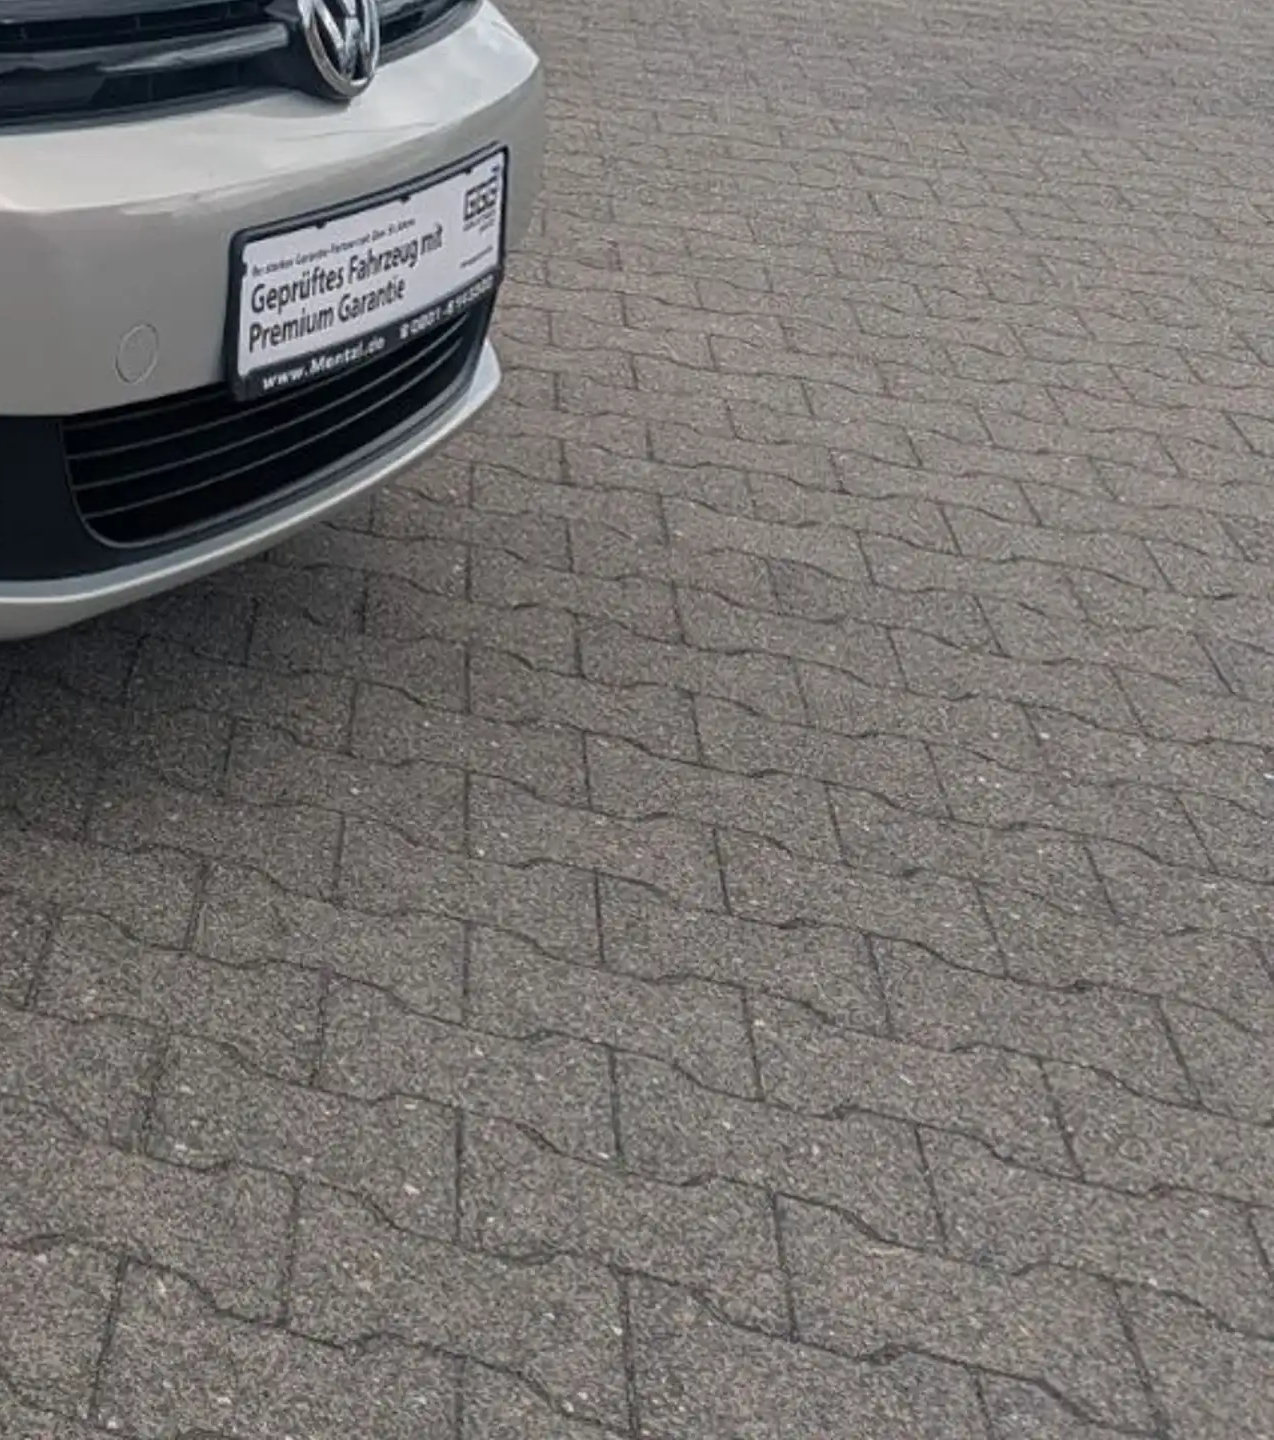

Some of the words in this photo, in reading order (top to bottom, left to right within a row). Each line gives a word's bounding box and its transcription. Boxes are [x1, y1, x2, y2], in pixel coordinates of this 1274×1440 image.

[251, 266, 344, 315] Geprüftes
[348, 238, 419, 284] Fahrzeug
[420, 222, 443, 256] mit
[249, 307, 335, 353] Premium
[337, 276, 406, 323] Garantie
